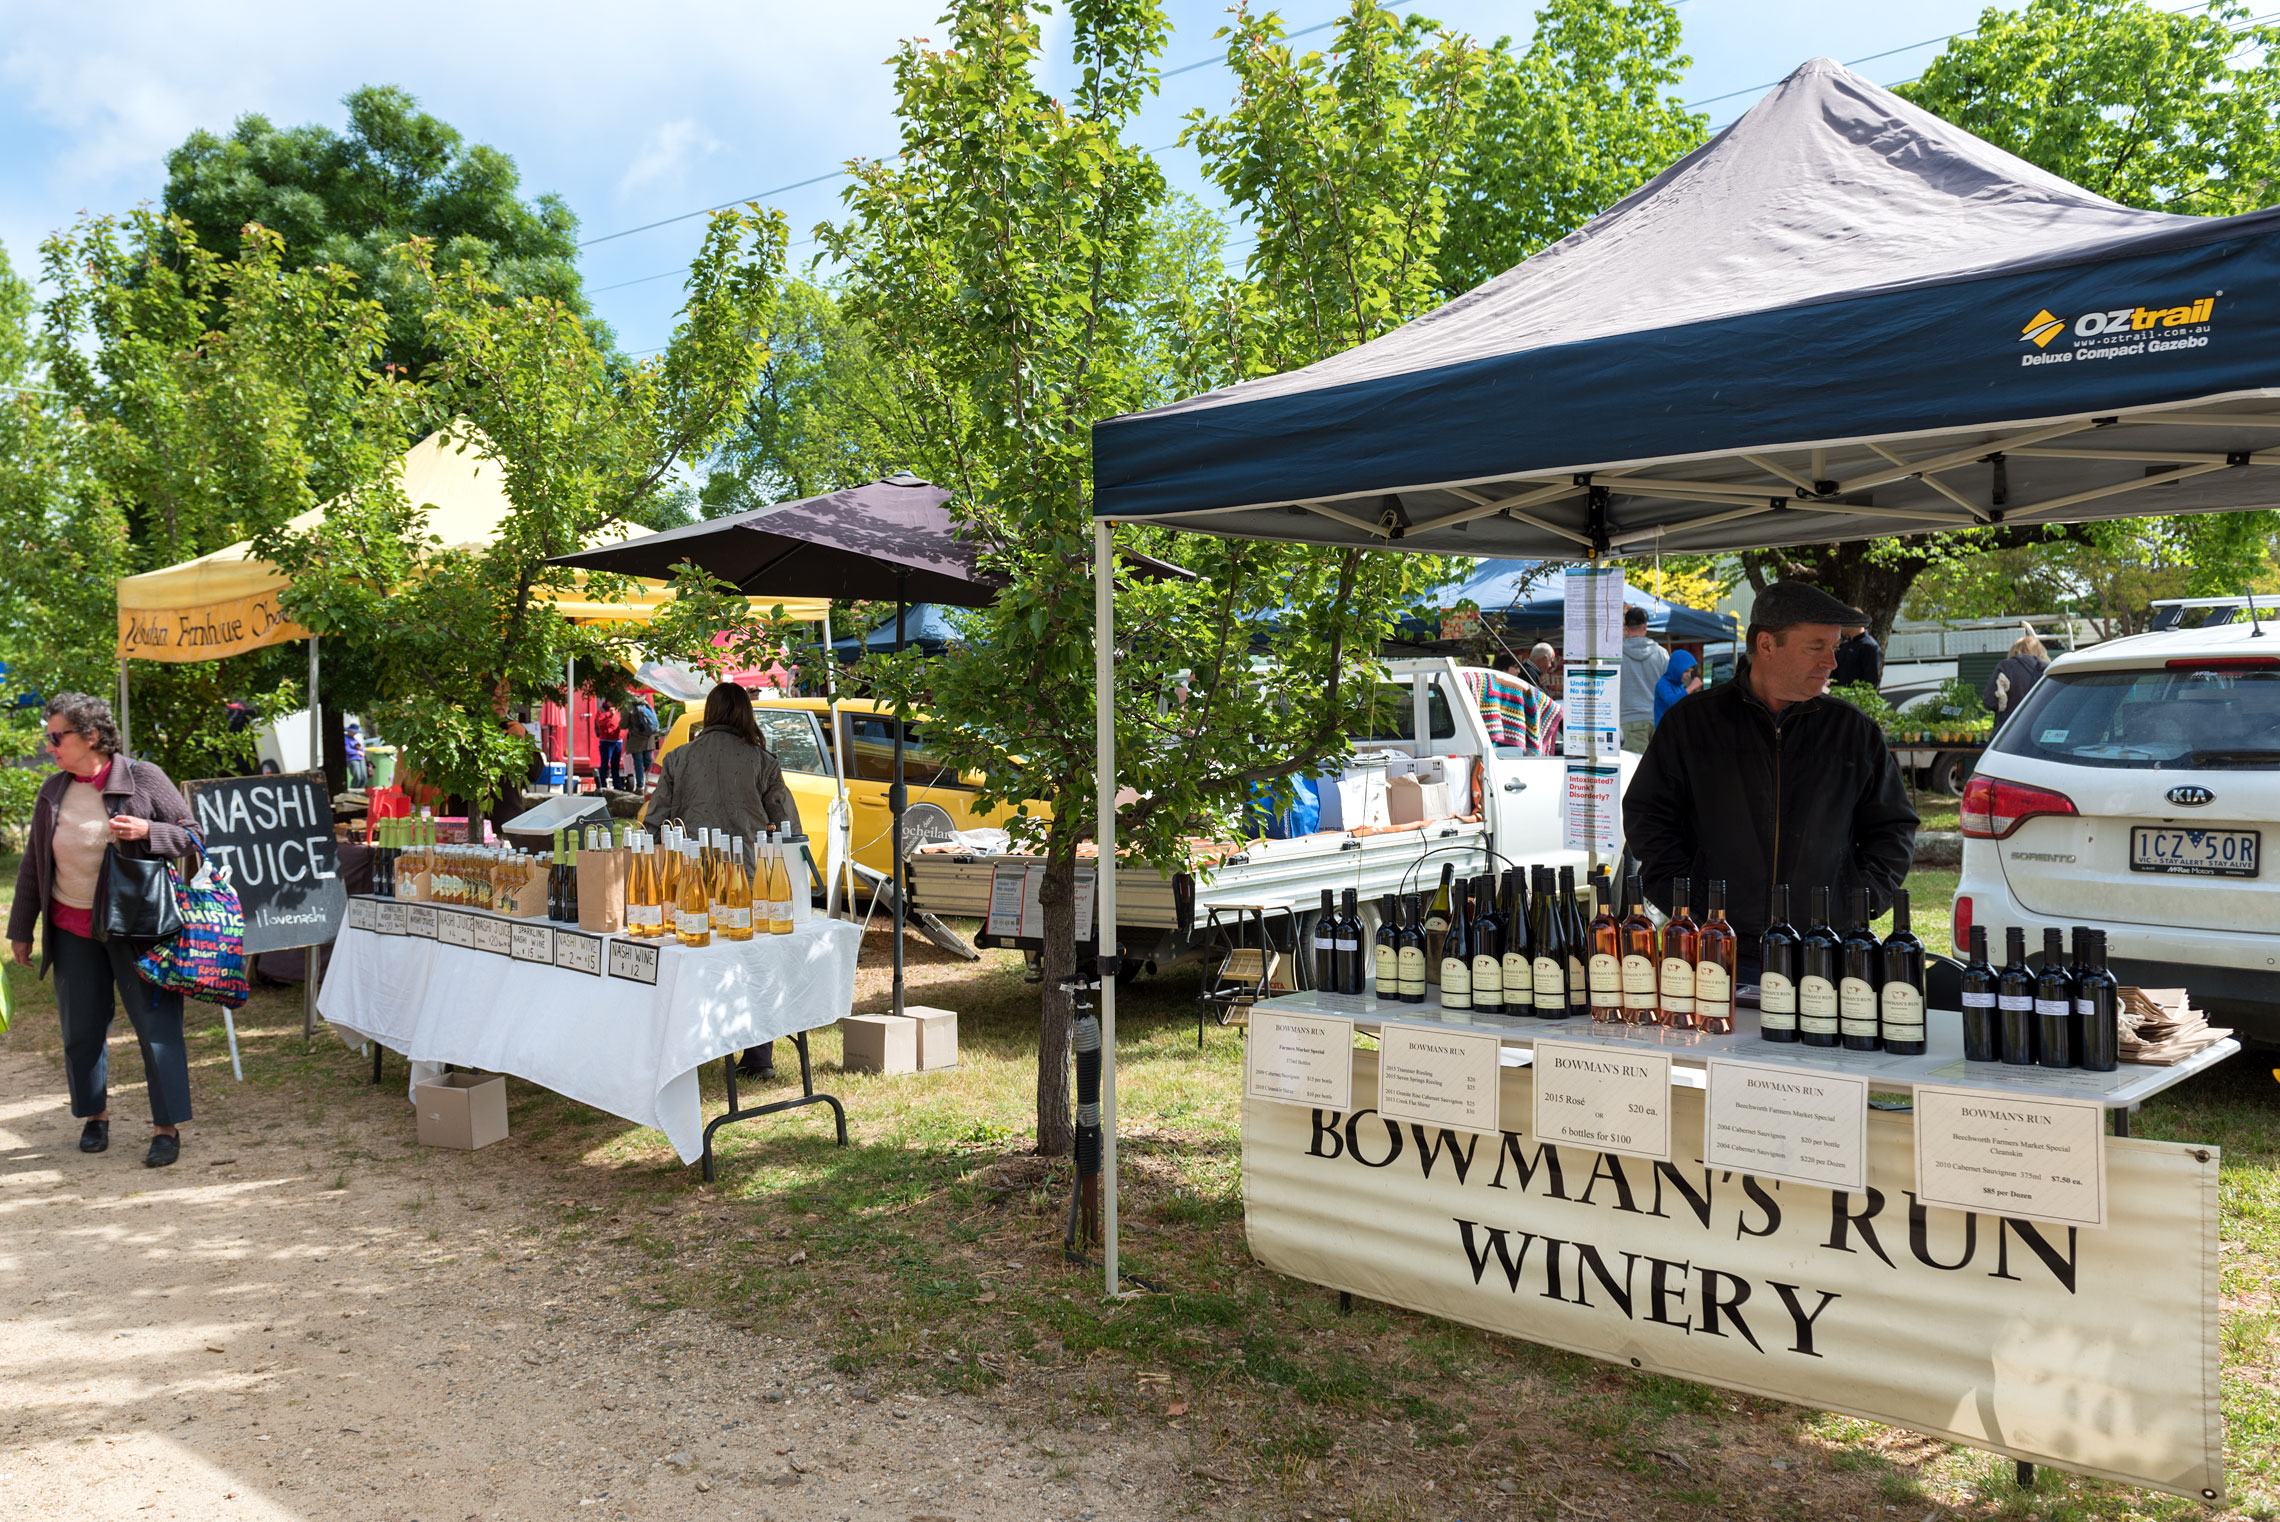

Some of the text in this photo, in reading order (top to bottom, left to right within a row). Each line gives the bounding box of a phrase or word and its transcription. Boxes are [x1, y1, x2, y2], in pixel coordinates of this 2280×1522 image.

[2021, 336, 2209, 367] Deluxe Compact Gazebo
[1581, 687, 1604, 696] supply
[1569, 775, 1614, 785] Intoxicated?
[1569, 783, 1594, 791] Drunk?
[1569, 791, 1610, 801] Disorderly?
[2172, 789, 2207, 802] KIA
[197, 784, 317, 835] NASHI
[2141, 833, 2183, 858] 1CZ
[206, 836, 337, 886] JUICE
[2011, 852, 2077, 863] SORENTO
[2230, 861, 2253, 869] ALIVE
[439, 913, 474, 931] NASHI JUICE
[474, 919, 511, 937] NASHI JUICE
[519, 926, 545, 939] SPARKLING
[513, 935, 545, 949] NASHI WINE
[558, 935, 597, 954] NASHI WINE
[569, 951, 574, 965] 2
[612, 944, 655, 966] NASHI WINE
[1276, 1024, 1325, 1036] BOWMAN'S RUN
[1409, 1042, 1466, 1056] BOWMAN'S RUN
[1555, 1058, 1648, 1078] BOWMAN'S RUN
[1426, 1078, 1442, 1087] Riesling
[1747, 1079, 1824, 1097] BOWMAN'S RUN
[1440, 1096, 1463, 1105] Sauvignon
[1545, 1093, 1658, 1116] 2015 Rosé $20 ea.
[1735, 1102, 1836, 1122] Beechworth Farmers Market Special
[1961, 1107, 2051, 1125] BOWMAN'S RUN
[1568, 1127, 1594, 1139] bottles
[1597, 1131, 1608, 1140] for
[1611, 1133, 1631, 1144] $100
[1717, 1123, 1840, 1149] 2004 Cabernet Sauvignon $20 per bottle
[1952, 1133, 2071, 1153] Beechworth Farmers Market Special
[1717, 1142, 1846, 1168] 2004 Cabernet Sauvignon $220 per Dozen
[1990, 1147, 2023, 1157] Cleanskin
[1936, 1160, 2083, 1186] 2010 Cabernet Sauvignon 375ml $7.50 ea.
[1982, 1186, 2033, 1200] $85 per Dozen
[1820, 1182, 2078, 1293] RUN
[1452, 1218, 1842, 1358] WINERY
